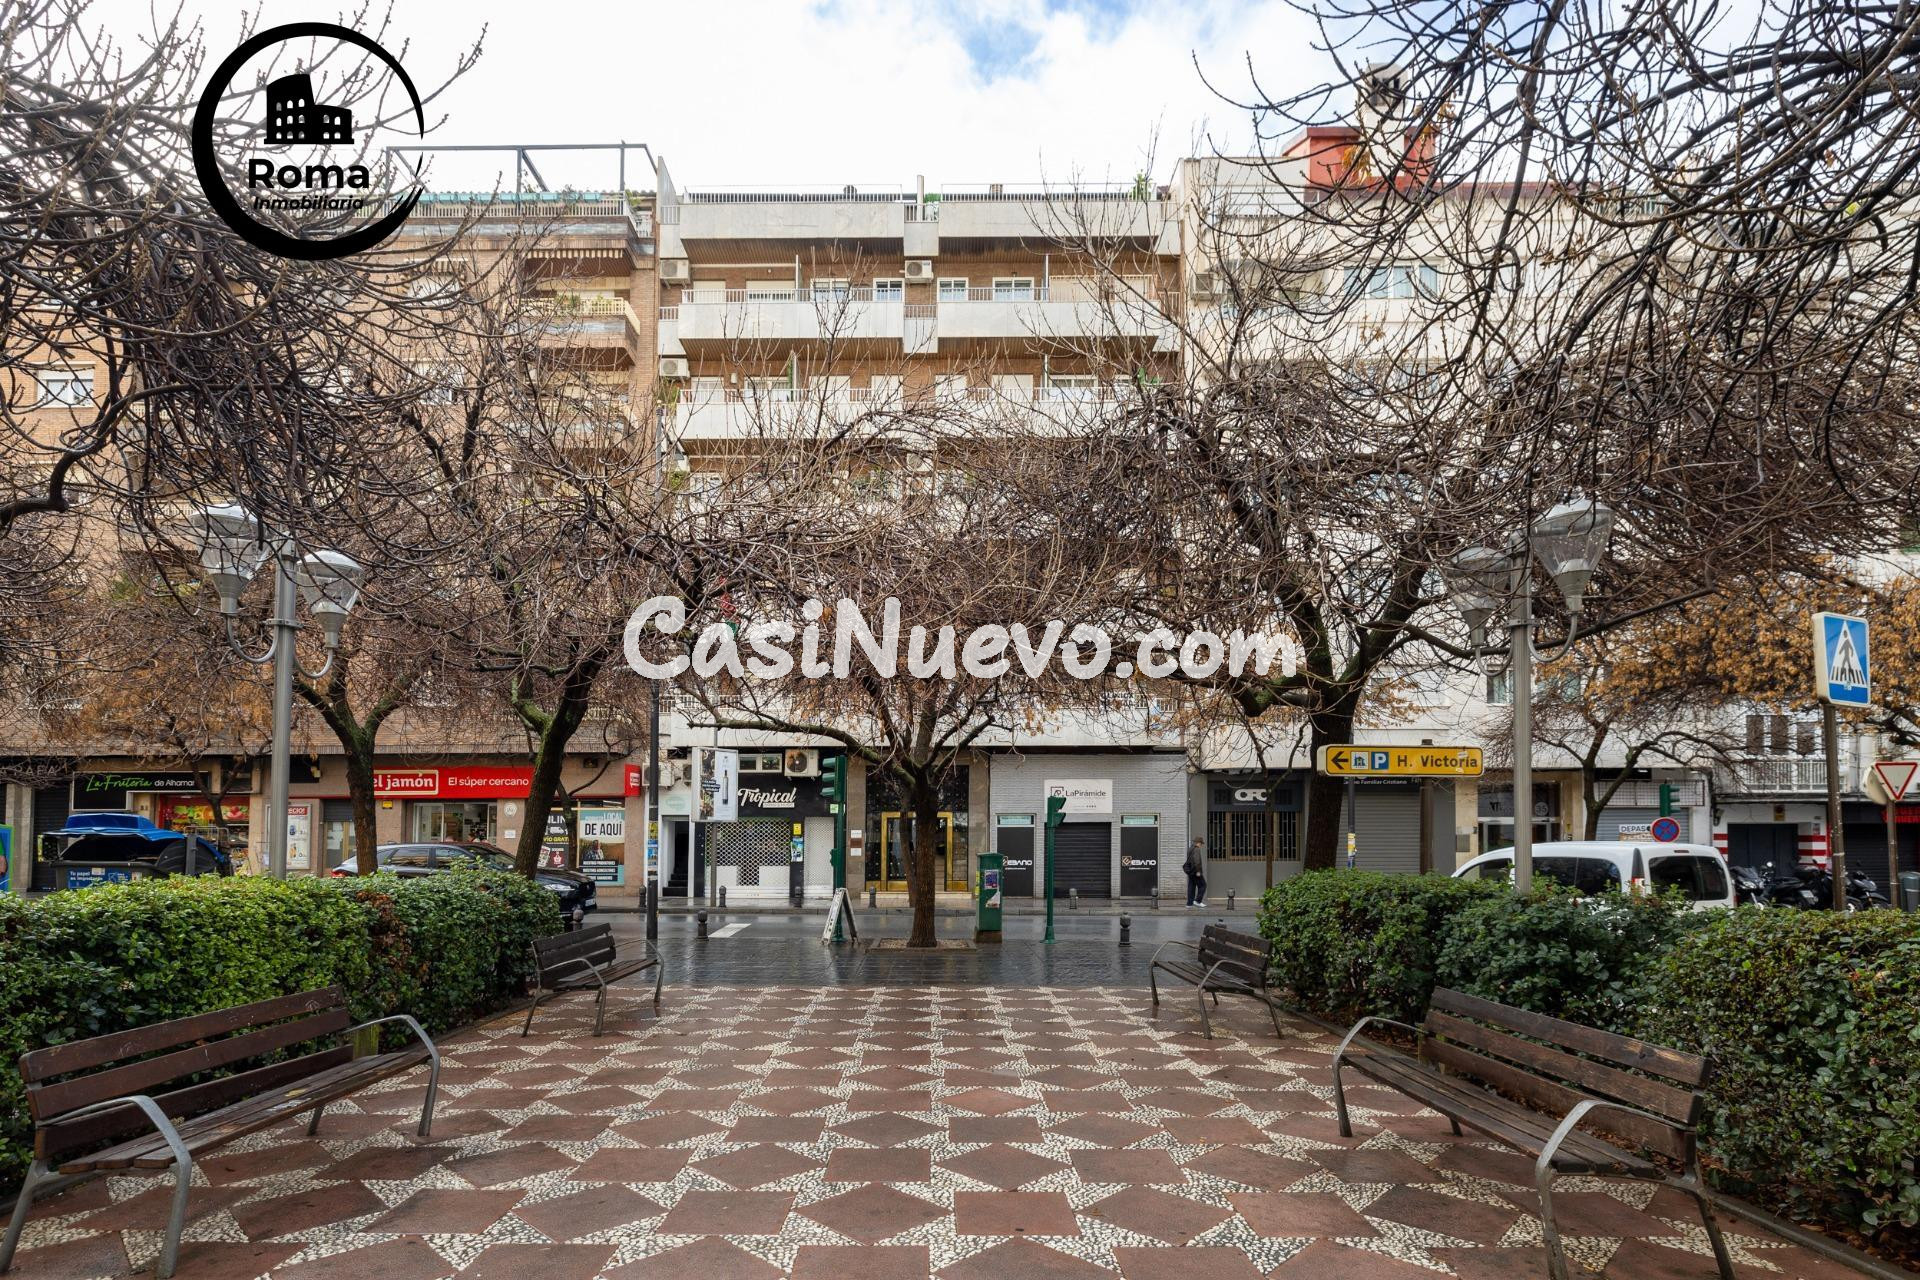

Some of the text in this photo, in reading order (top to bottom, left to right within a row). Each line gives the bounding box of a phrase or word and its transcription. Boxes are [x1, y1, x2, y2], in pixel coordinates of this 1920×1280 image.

[1374, 753, 1386, 768] P
[1397, 755, 1413, 767] H.
[85, 775, 103, 792] La
[385, 774, 434, 790] jamón
[448, 776, 529, 789] El súper cercano
[737, 787, 797, 807] Tropical
[1065, 789, 1107, 797] LaPirámide
[585, 821, 622, 836] DE AQUÍ
